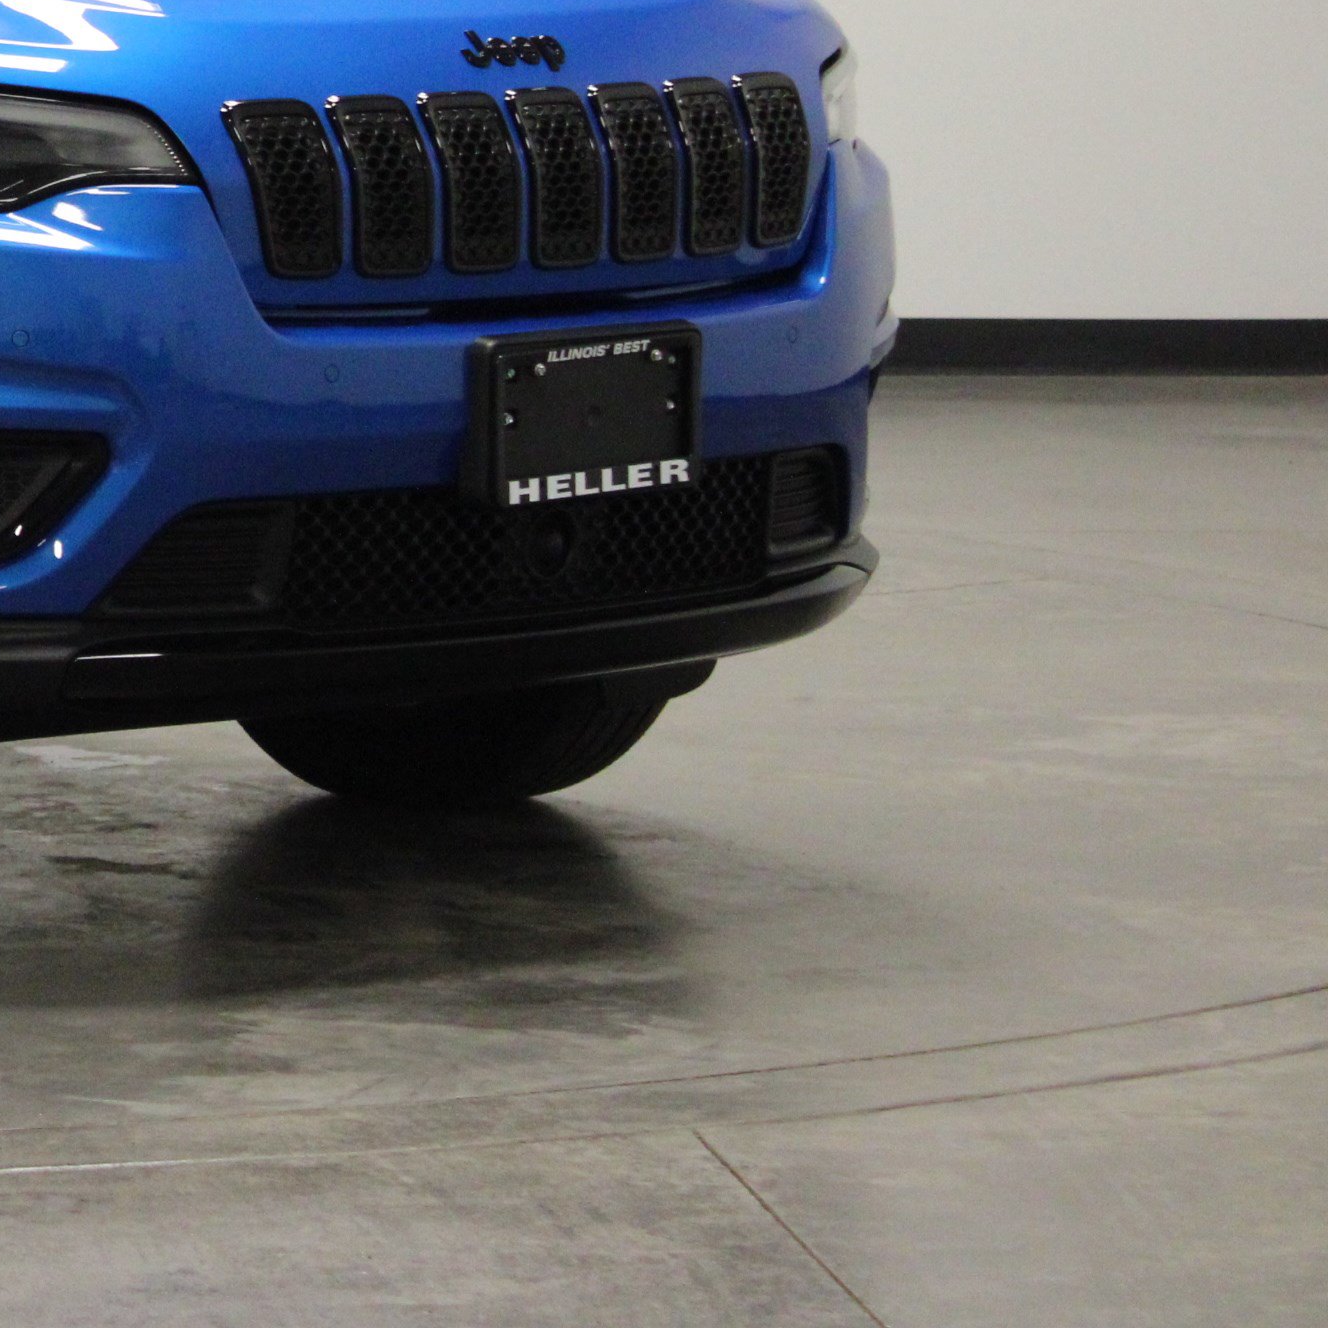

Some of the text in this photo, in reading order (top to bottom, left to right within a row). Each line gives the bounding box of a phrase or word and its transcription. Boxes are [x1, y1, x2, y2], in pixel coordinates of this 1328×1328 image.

[460, 30, 566, 73] Jeep
[612, 339, 651, 356] BEST
[507, 458, 690, 505] HELLER
